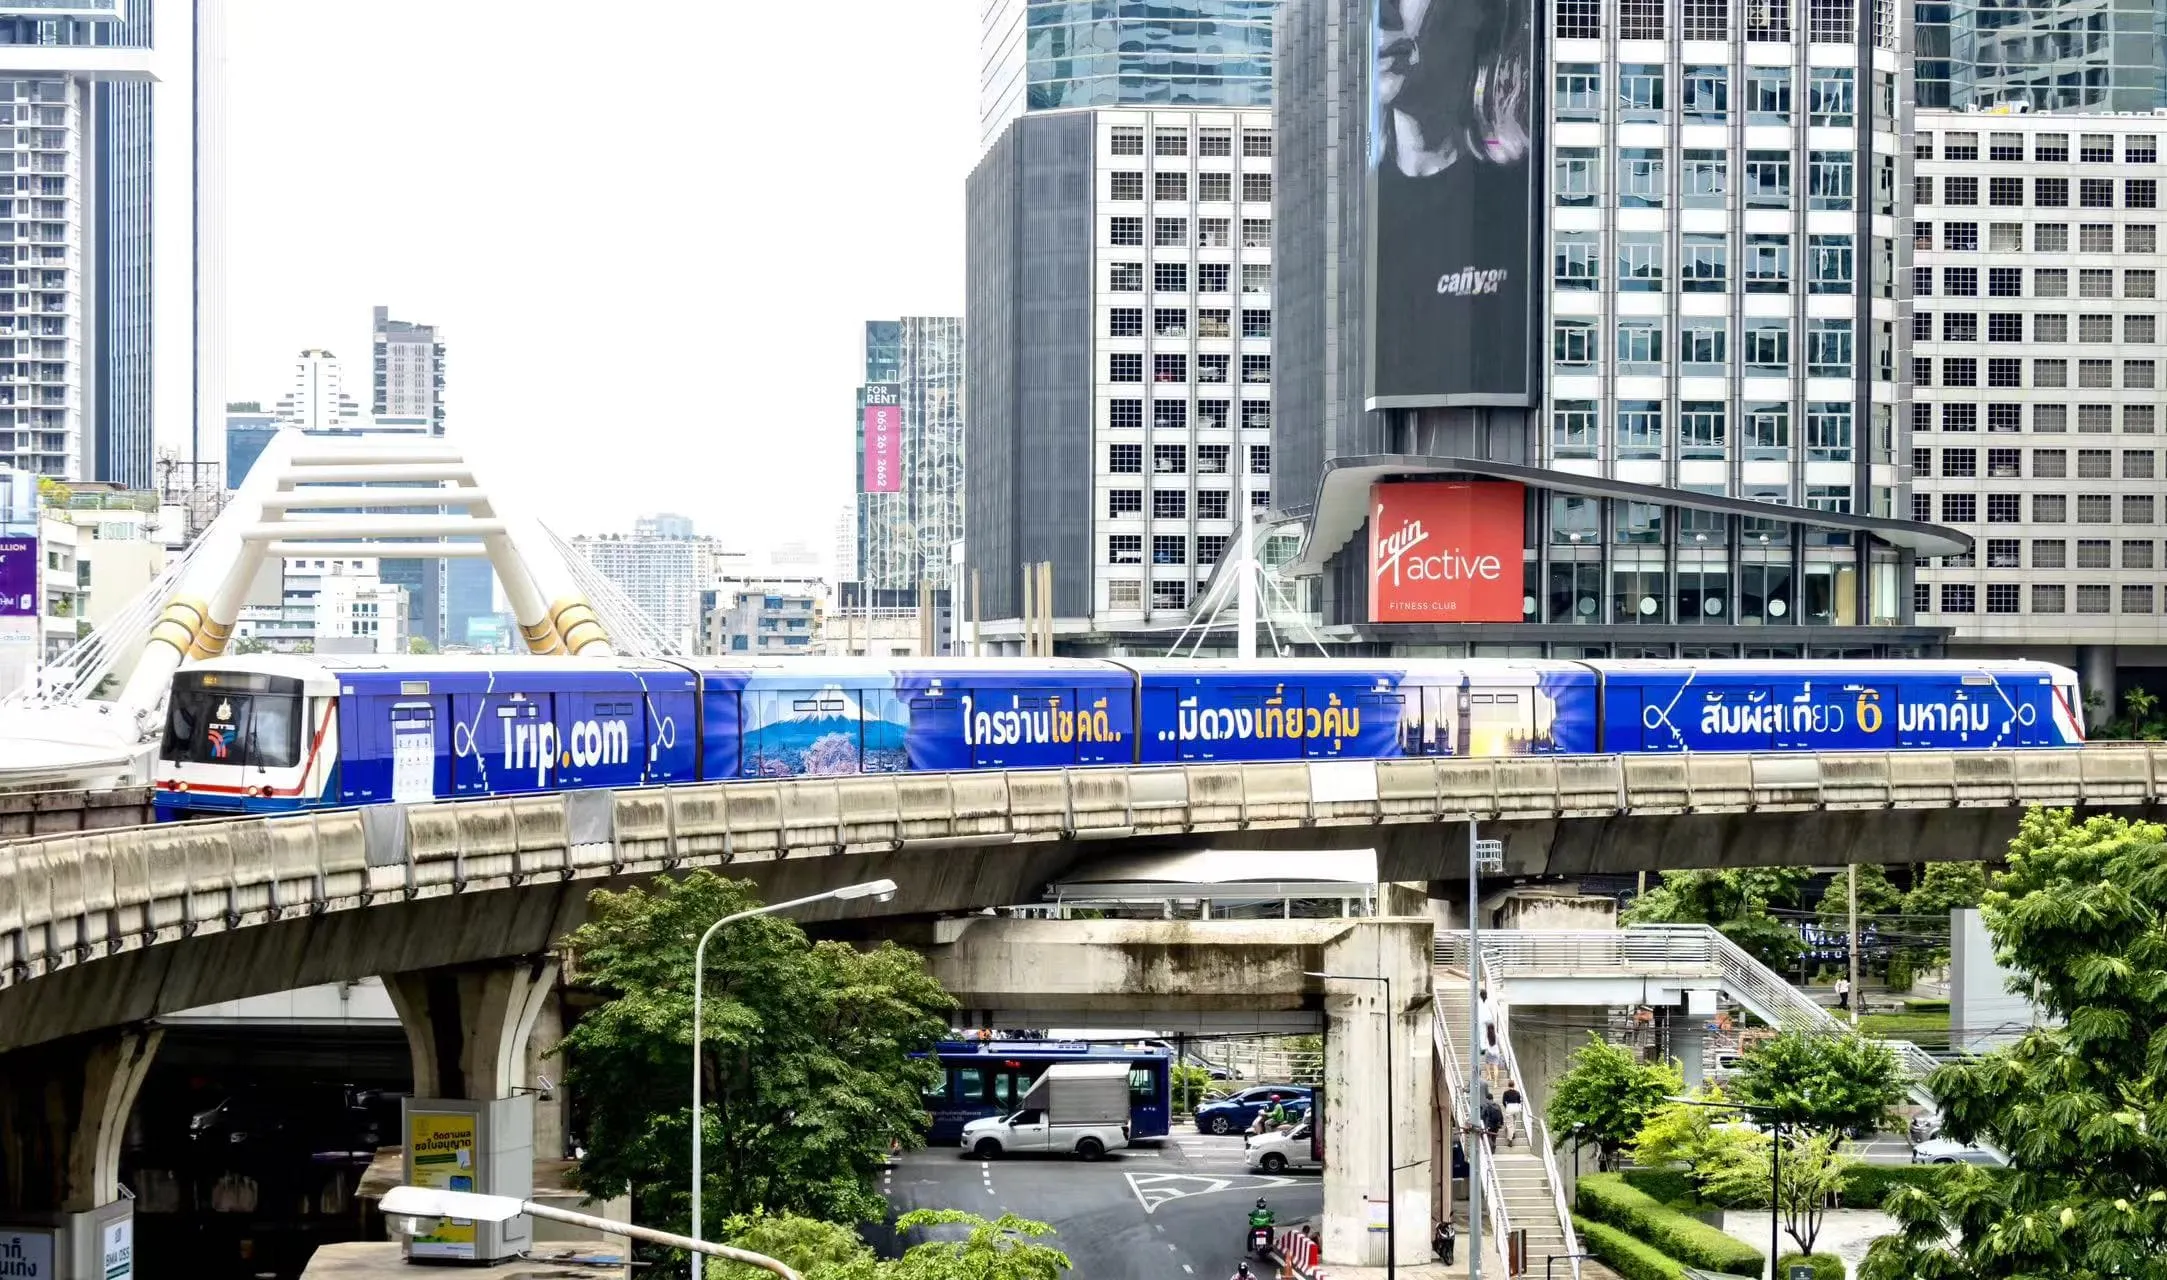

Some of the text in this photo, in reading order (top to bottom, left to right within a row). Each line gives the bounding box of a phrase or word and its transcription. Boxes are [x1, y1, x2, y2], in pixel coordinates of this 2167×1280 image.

[867, 386, 888, 395] FOR
[867, 395, 897, 404] RENT
[877, 410, 887, 487] 063 261 2662
[1407, 548, 1501, 580] active
[1390, 602, 1457, 610] FITNESS CLUB
[1856, 688, 1883, 733] 6
[1898, 689, 1989, 741] มหาคุ้ม
[497, 702, 629, 787] Trip.com
